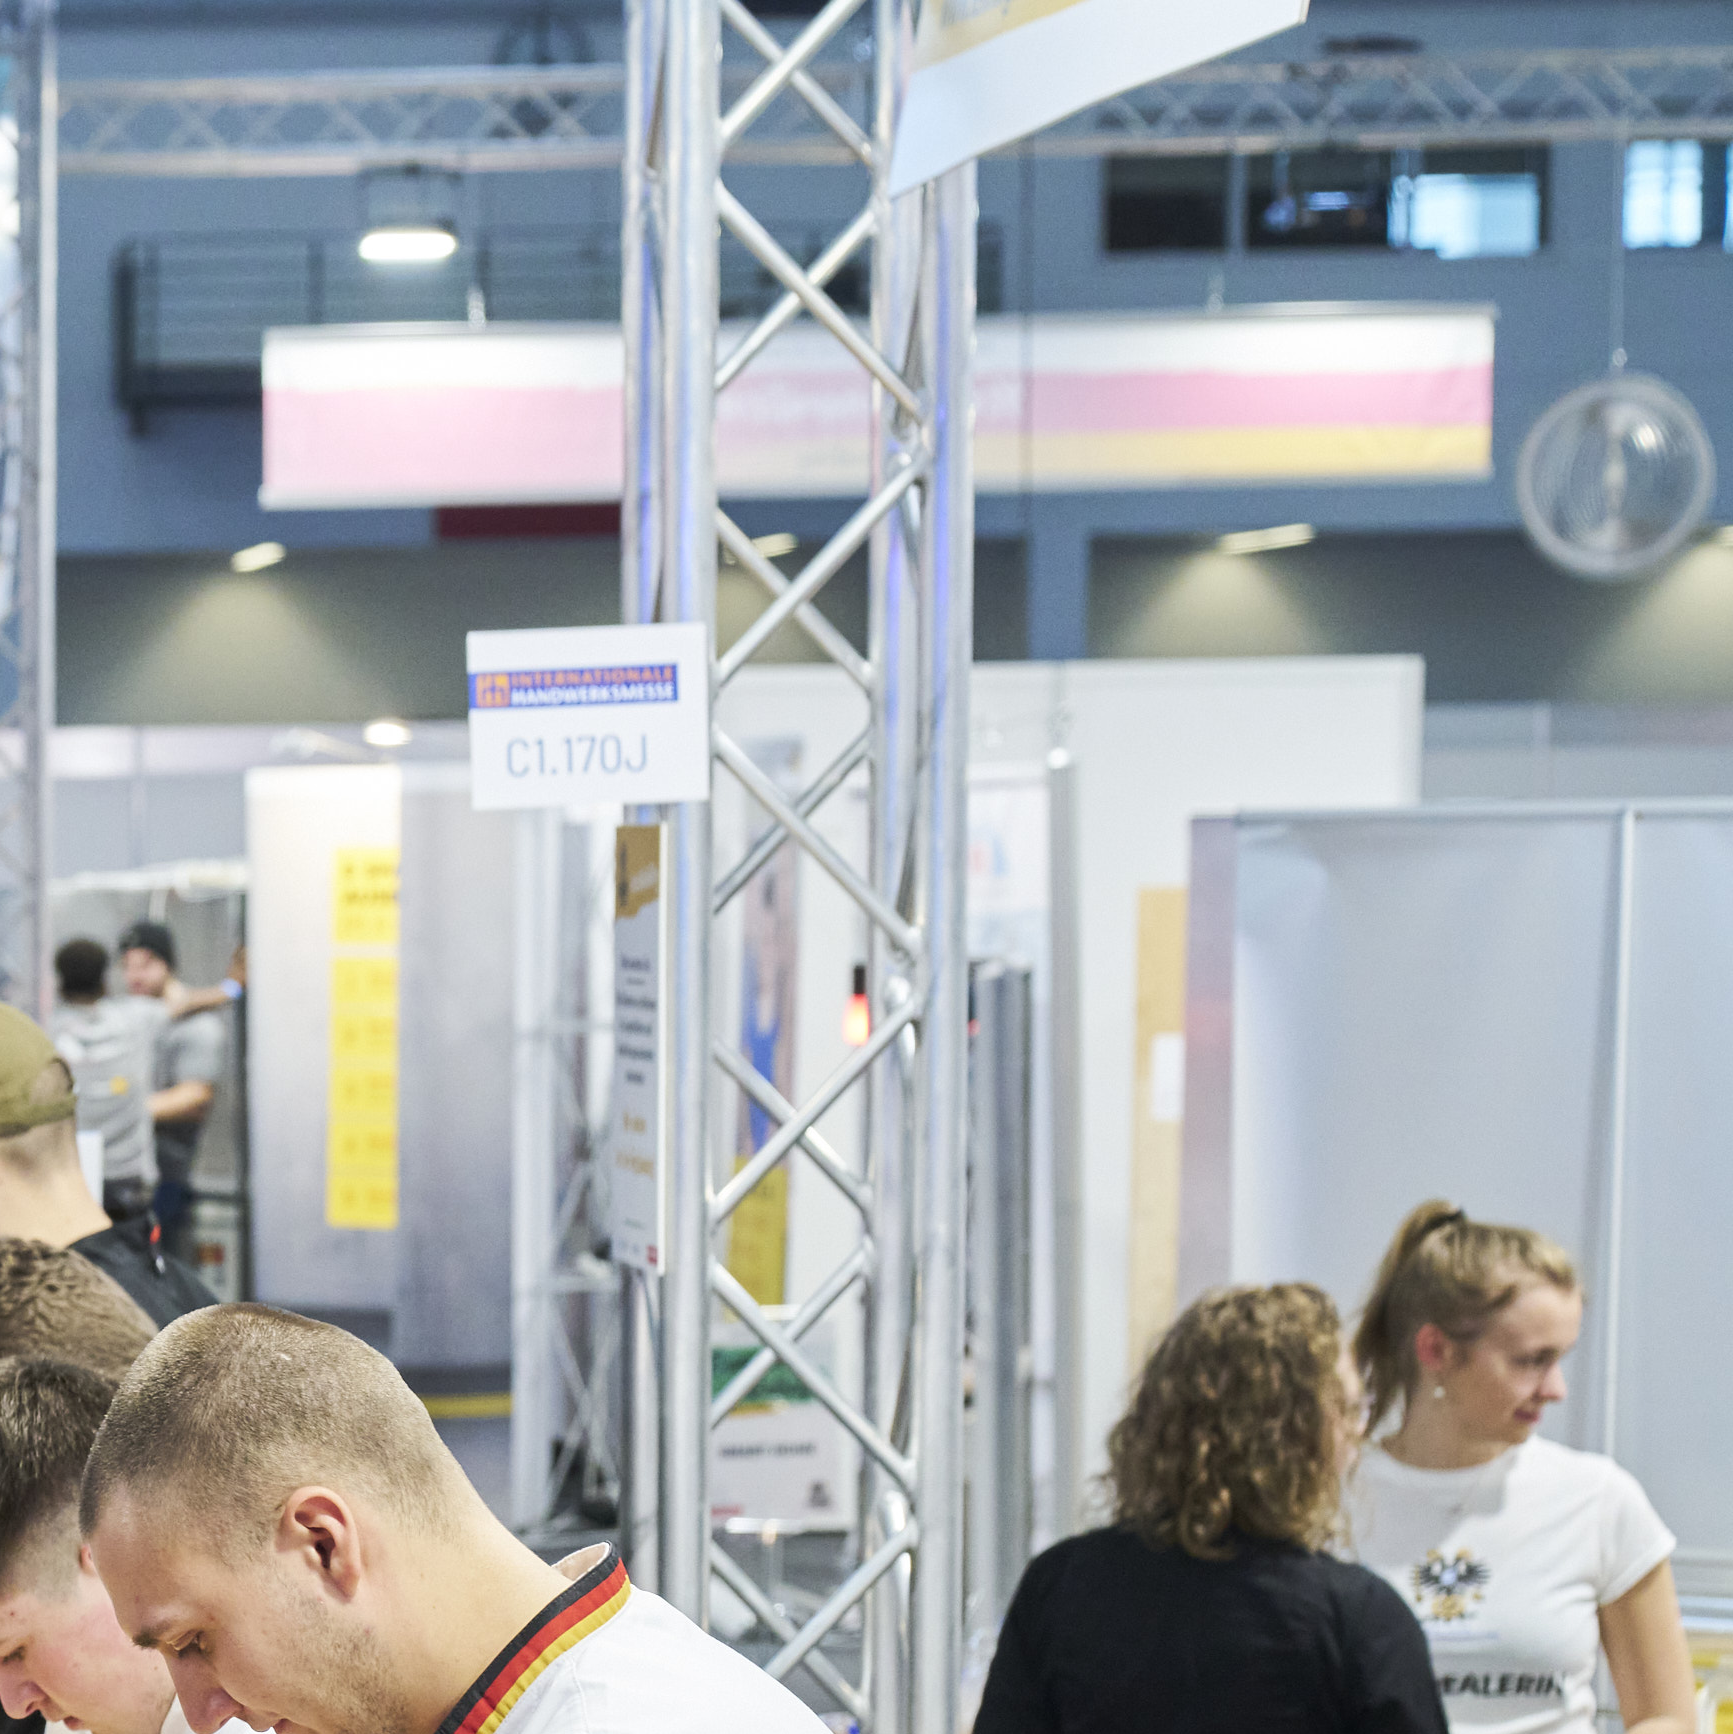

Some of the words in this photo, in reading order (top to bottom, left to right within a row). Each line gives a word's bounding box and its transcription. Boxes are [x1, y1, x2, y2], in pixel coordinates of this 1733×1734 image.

[511, 664, 675, 688] INTERNATIONALE
[510, 682, 675, 707] HANDWERKSMESSE
[506, 733, 648, 779] C1.170J
